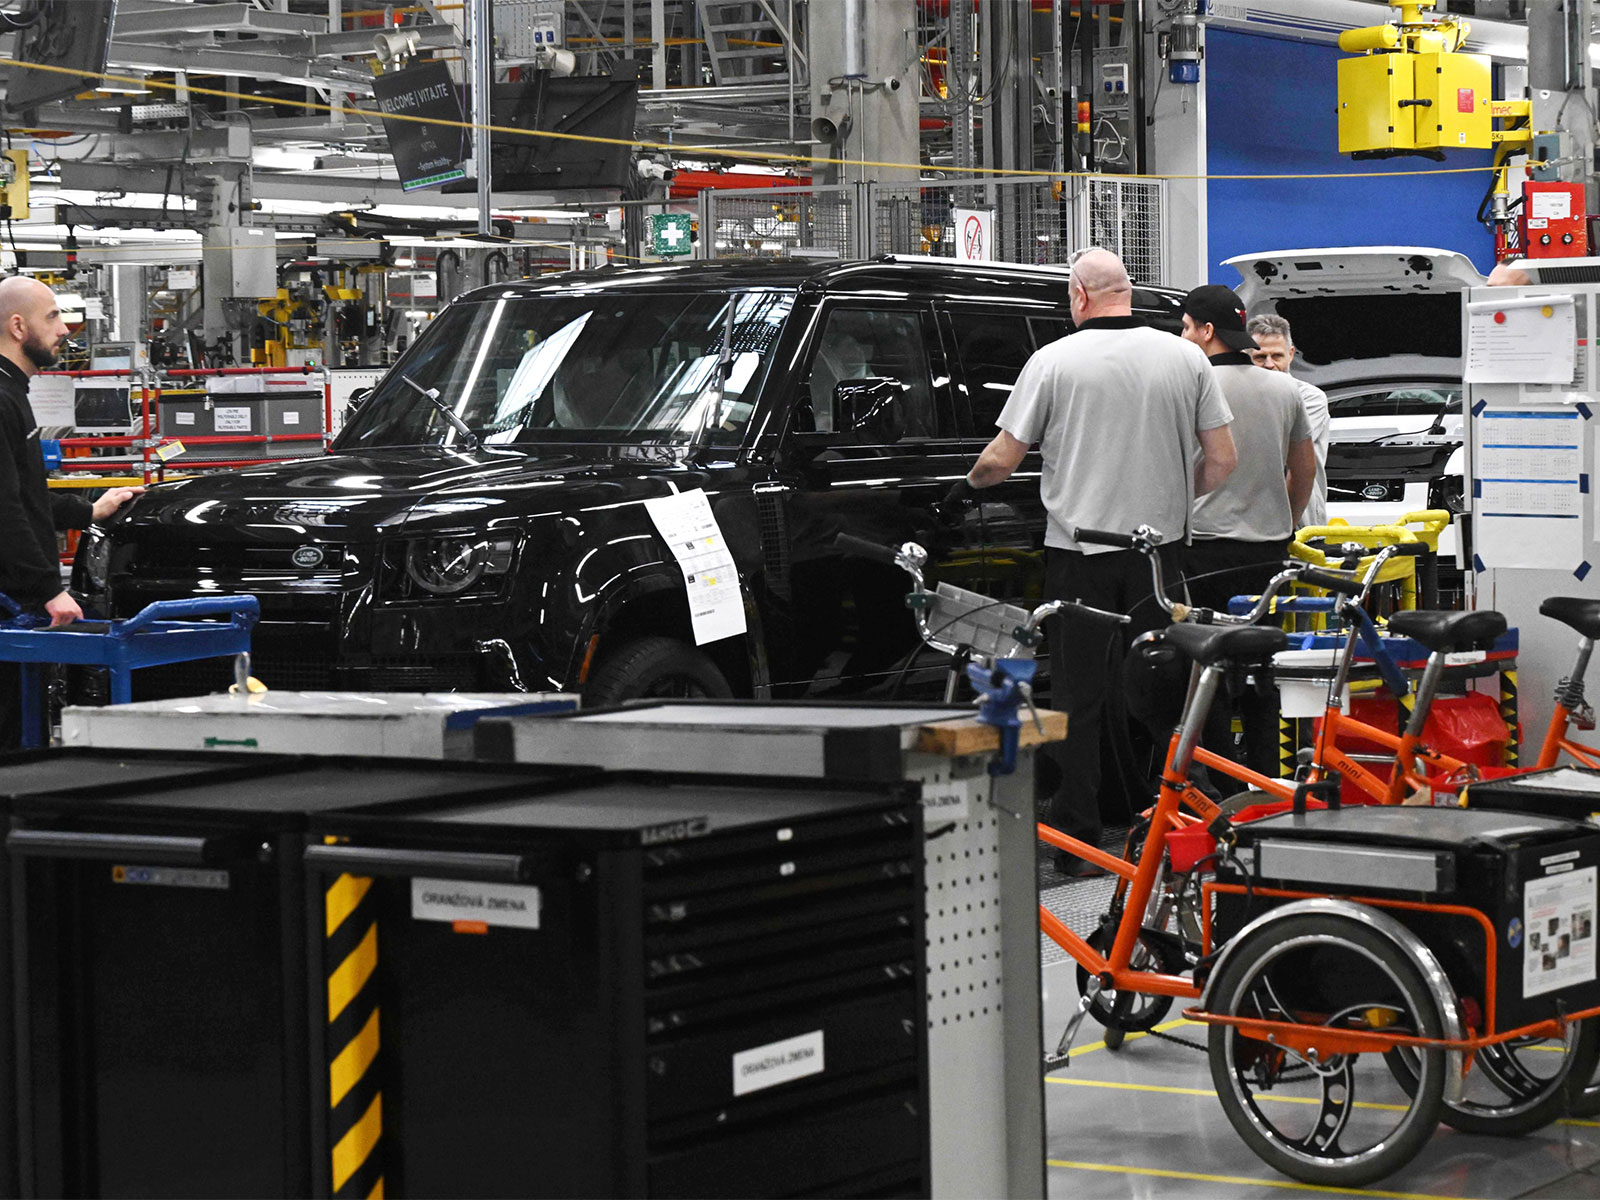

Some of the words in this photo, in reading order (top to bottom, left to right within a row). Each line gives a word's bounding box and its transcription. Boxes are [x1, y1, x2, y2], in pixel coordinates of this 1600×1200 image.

[379, 91, 415, 113] WELCOME
[418, 82, 449, 103] VITAJTE
[1337, 760, 1363, 781] mini
[1184, 791, 1211, 814] mini
[487, 896, 527, 911] ZMENA
